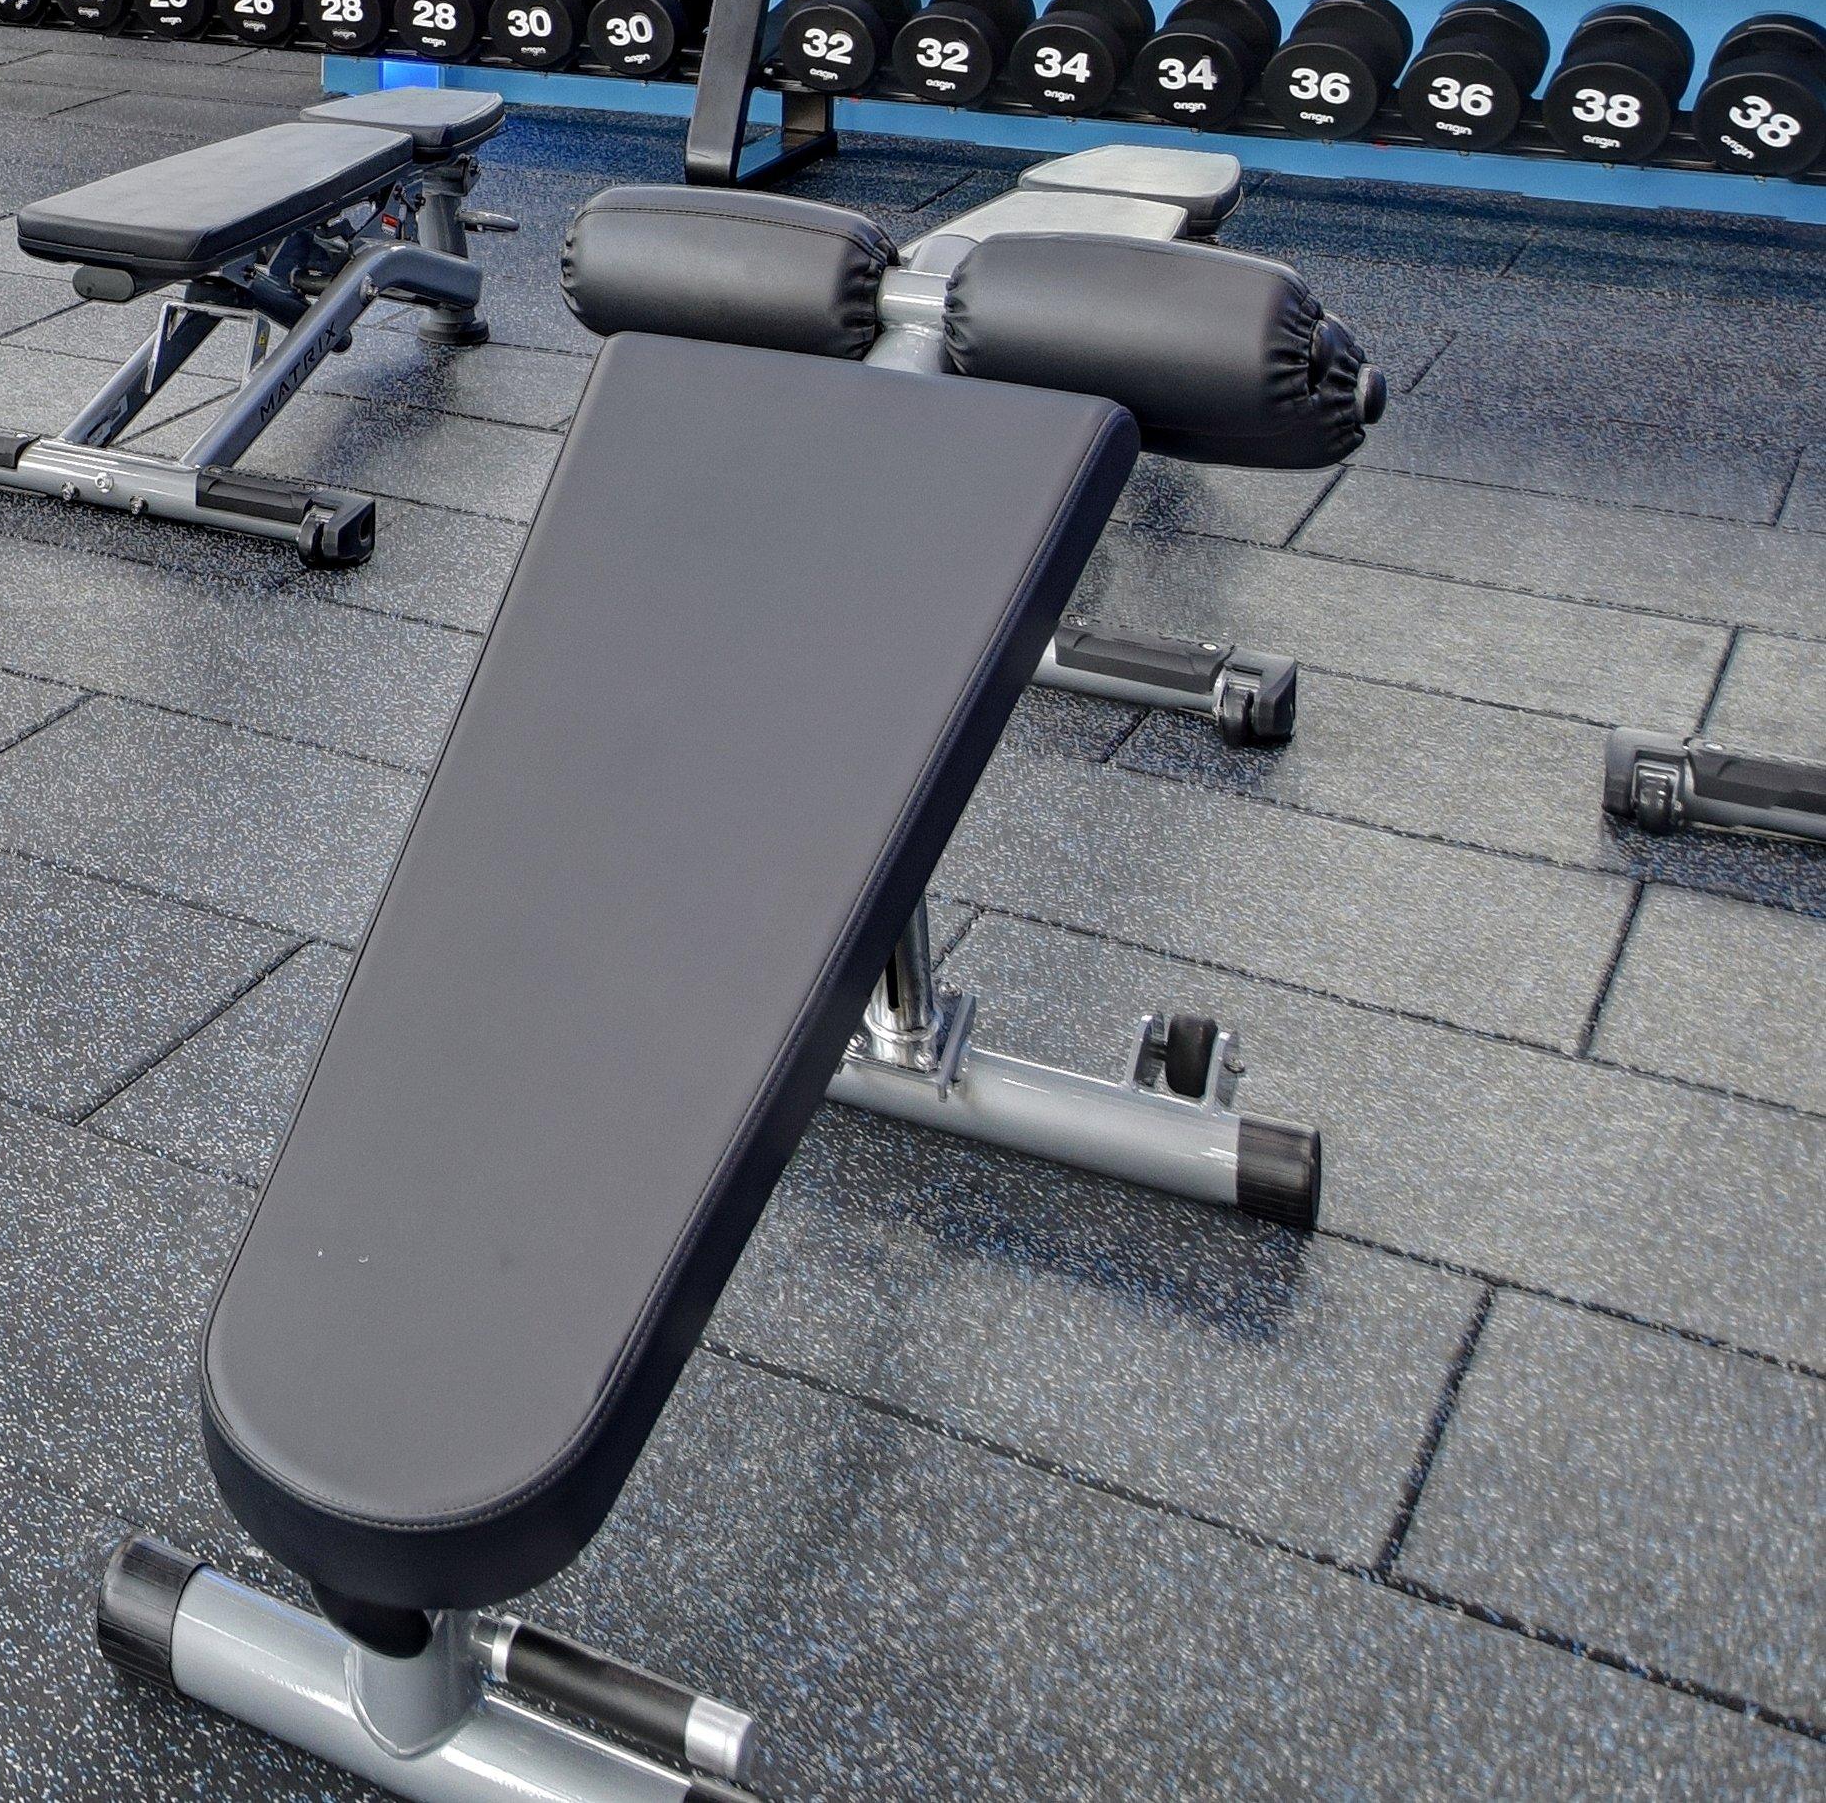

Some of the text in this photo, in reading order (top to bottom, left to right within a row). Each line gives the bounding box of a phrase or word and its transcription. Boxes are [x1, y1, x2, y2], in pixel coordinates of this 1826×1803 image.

[412, 0, 457, 31] 28
[507, 8, 552, 38] 30
[606, 14, 653, 46] 30
[802, 27, 854, 65] 32
[916, 37, 970, 73] 32
[1034, 46, 1091, 84] 34
[1158, 57, 1218, 91] 34
[1288, 67, 1351, 105] 36
[1427, 76, 1494, 117] 36
[1572, 88, 1641, 128] 38
[1728, 95, 1802, 149] 38
